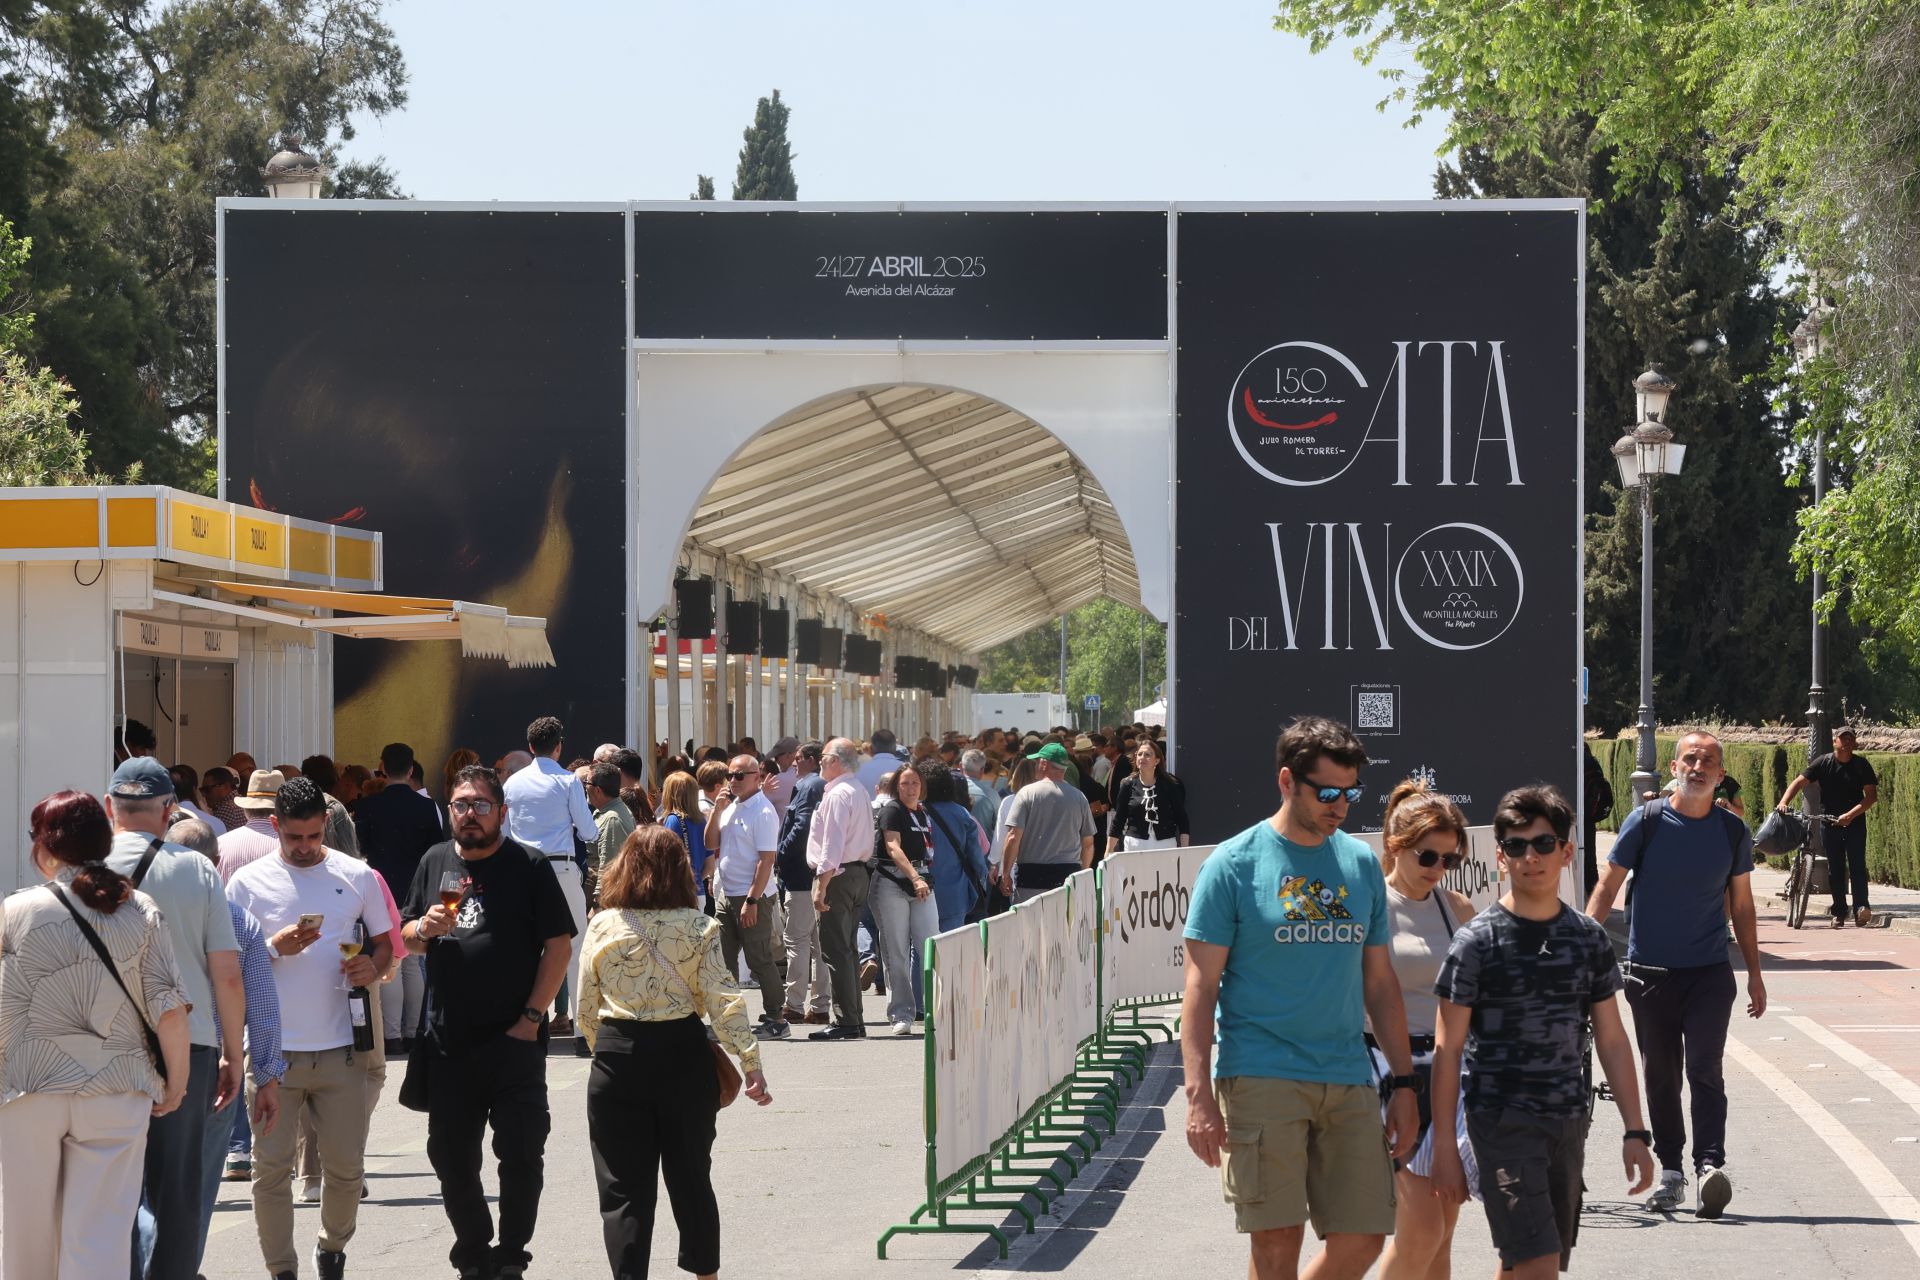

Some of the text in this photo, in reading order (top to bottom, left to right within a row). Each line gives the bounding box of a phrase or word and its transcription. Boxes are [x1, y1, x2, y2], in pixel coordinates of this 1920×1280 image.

[867, 256, 932, 277] ABRIL
[932, 256, 986, 278] 2025
[845, 283, 956, 296] Avenida del Alcázar
[1275, 367, 1327, 394] 150
[1257, 396, 1346, 406] aniversario
[1227, 340, 1525, 487] CATA
[1259, 436, 1316, 445] JULIO ROMERO
[1295, 447, 1305, 455] DE
[1420, 550, 1499, 587] XXXIX
[1228, 522, 1524, 650] DEL VINO
[1422, 610, 1461, 619] MONTILLA
[1368, 758, 1391, 766] ganizan
[1273, 920, 1365, 944] adidas
